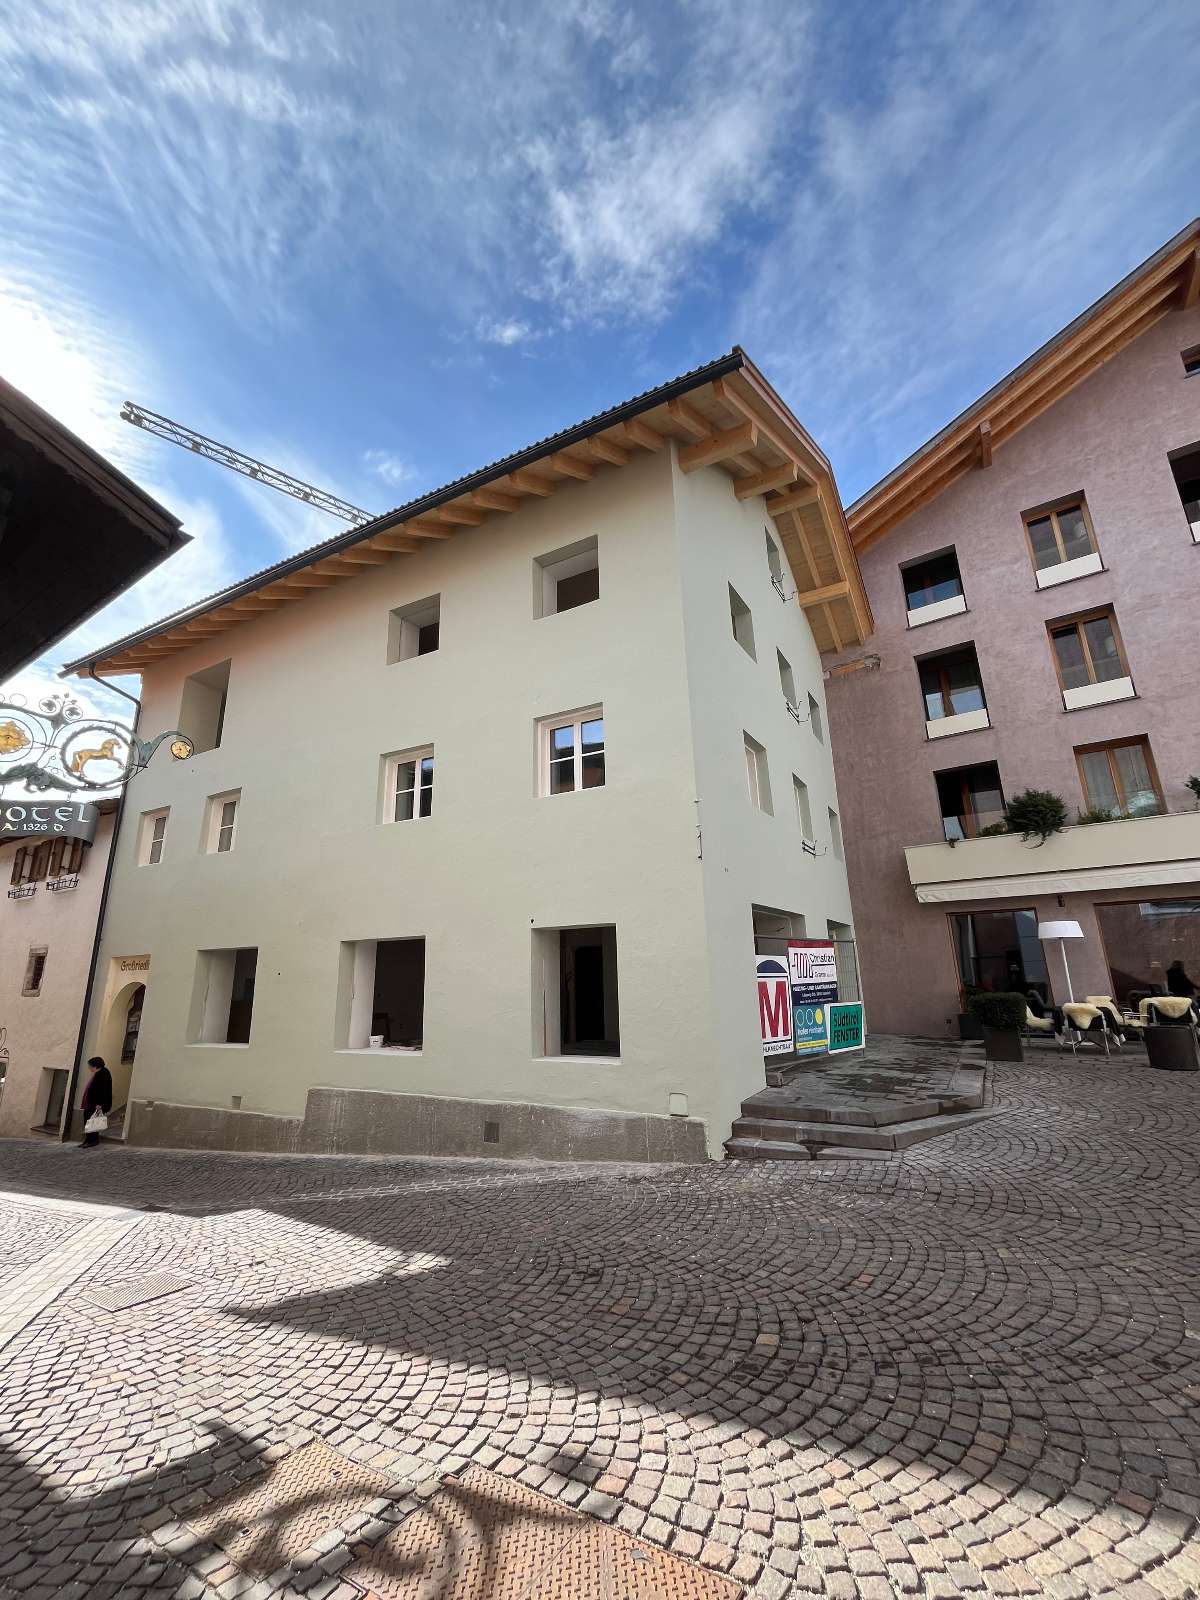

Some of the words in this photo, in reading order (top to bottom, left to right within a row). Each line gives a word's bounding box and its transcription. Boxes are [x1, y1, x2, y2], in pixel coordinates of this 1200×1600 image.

[0, 804, 90, 823] OTEL
[757, 981, 790, 1039] M
[834, 1010, 858, 1028] Südtirol
[833, 1027, 860, 1042] FENSTER
